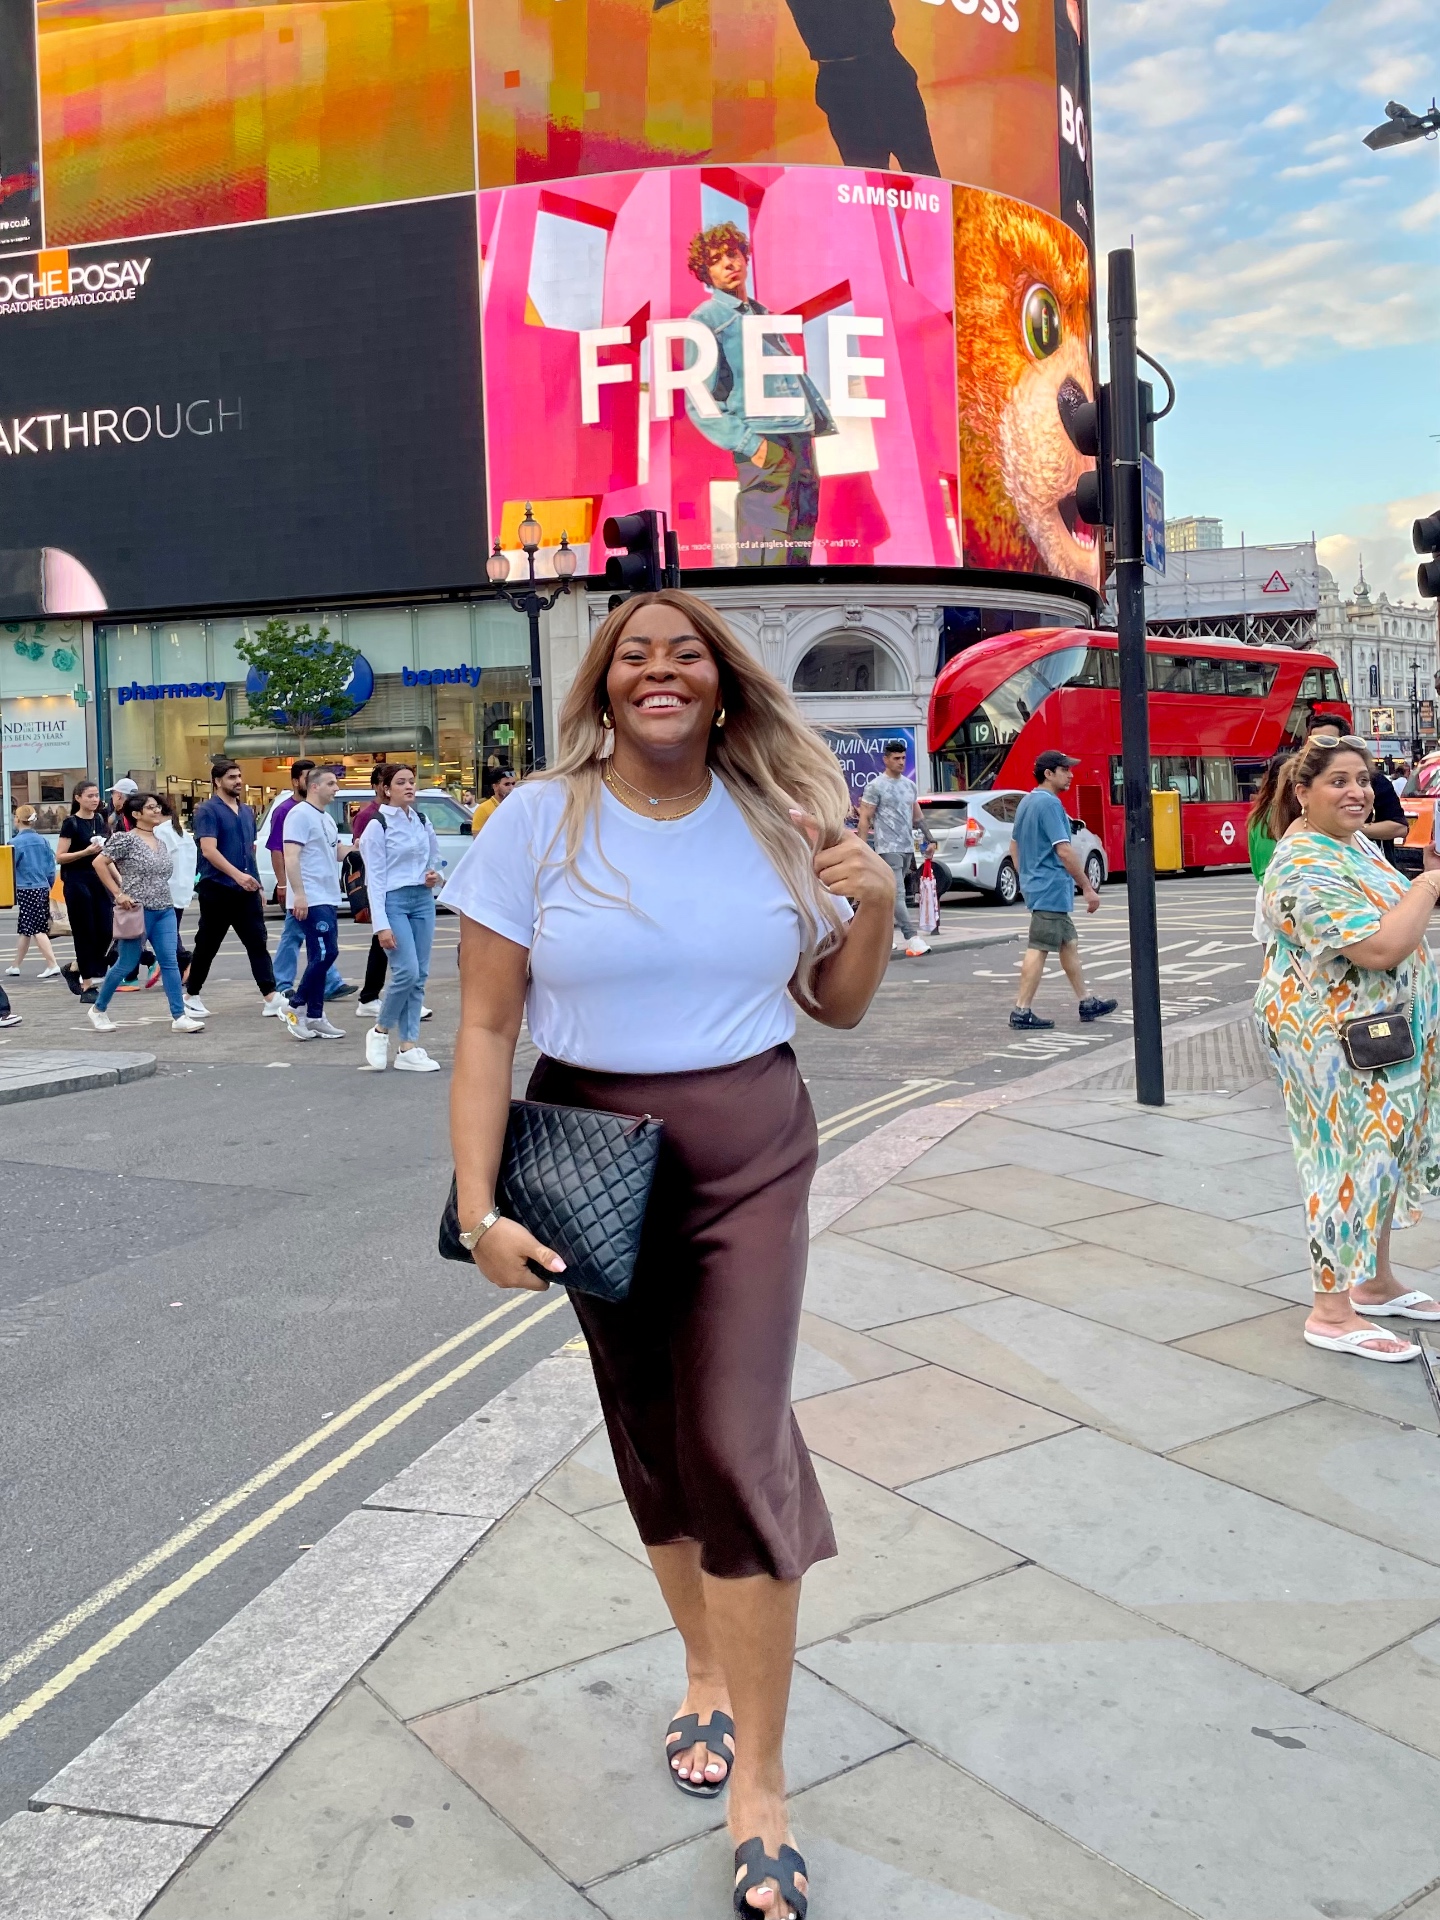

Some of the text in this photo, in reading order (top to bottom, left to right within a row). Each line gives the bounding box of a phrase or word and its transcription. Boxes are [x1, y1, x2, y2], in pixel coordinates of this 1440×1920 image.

[920, 0, 1020, 33] SS
[837, 184, 940, 213] SAMSUNG
[68, 257, 152, 294] POSAY
[45, 288, 136, 310] DERMATOLOGIQUE
[579, 315, 886, 424] FREE
[0, 397, 243, 455] AKTHROUGH
[713, 540, 749, 551] supported
[751, 541, 759, 549] at
[760, 540, 784, 550] angles
[830, 539, 843, 547] and
[403, 663, 482, 688] beauty
[117, 681, 226, 705] pharmacy
[34, 720, 67, 732] THAT
[975, 724, 990, 742] 19
[851, 771, 883, 788] ICO
[983, 1031, 1114, 1061] LOOK
